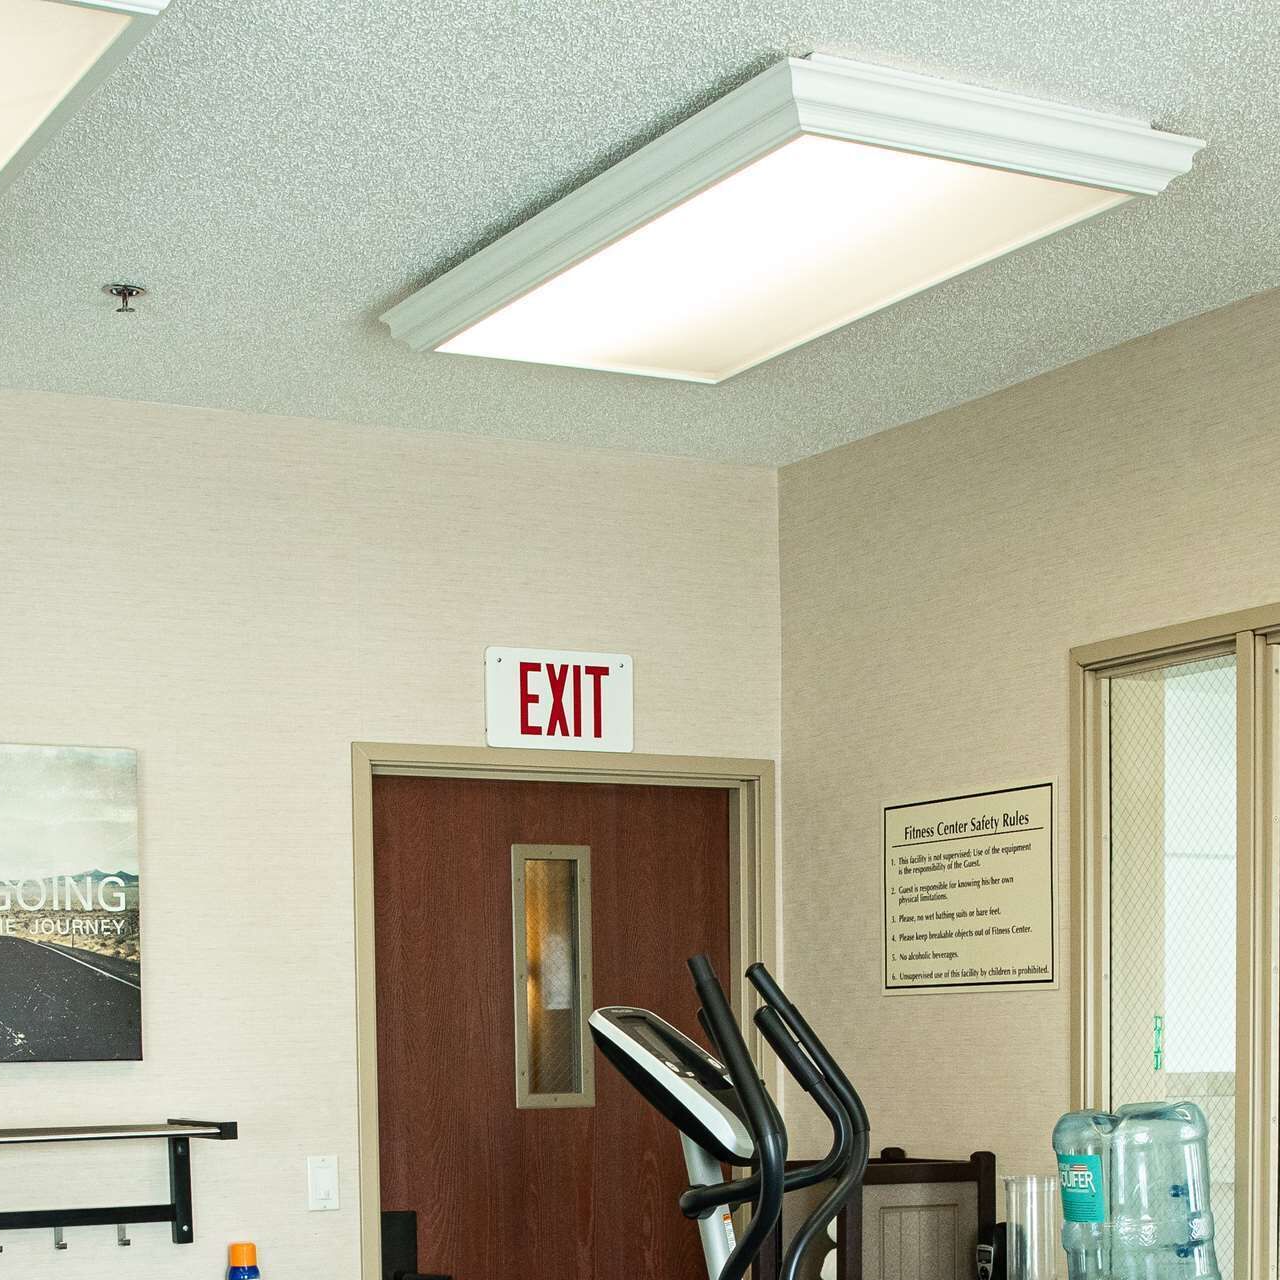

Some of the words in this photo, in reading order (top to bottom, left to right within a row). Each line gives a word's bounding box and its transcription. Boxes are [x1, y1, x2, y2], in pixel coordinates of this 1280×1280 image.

[519, 661, 610, 738] EXIT
[904, 825, 934, 840] Fitness
[937, 821, 969, 836] Center
[970, 814, 999, 834] Safety
[1002, 810, 1030, 827] Rules
[898, 857, 909, 865] This
[909, 854, 927, 865] facility
[973, 848, 984, 857] Use
[984, 846, 991, 855] of
[991, 845, 1001, 854] the
[1001, 843, 1032, 855] equipment
[903, 866, 912, 874] the
[913, 863, 946, 876] responsibility
[947, 861, 953, 870] of
[954, 860, 962, 869] the
[898, 886, 913, 894] Guest
[919, 881, 948, 895] responsible
[948, 881, 957, 889] for
[957, 879, 981, 889] knowing
[898, 894, 920, 906] physical
[935, 910, 955, 921] bathing
[955, 909, 968, 918] suits
[975, 908, 988, 916] bare
[29, 919, 125, 935] JOURNEY
[899, 933, 915, 941] Please
[915, 932, 928, 942] keep
[928, 930, 954, 939] breakable
[954, 929, 974, 940] objects
[984, 927, 991, 935] of
[991, 926, 1011, 935] Fitness
[1011, 925, 1033, 934] Center.
[899, 953, 908, 961] No
[908, 951, 932, 960] alcoholic
[931, 950, 959, 960] beverages.
[899, 970, 934, 982] Unsupervised
[943, 969, 950, 978] of
[950, 969, 960, 977] this
[960, 968, 979, 979] facility
[980, 968, 987, 978] by
[988, 967, 1011, 976] children
[1011, 966, 1017, 975] is
[1017, 965, 1049, 976] prohibited.
